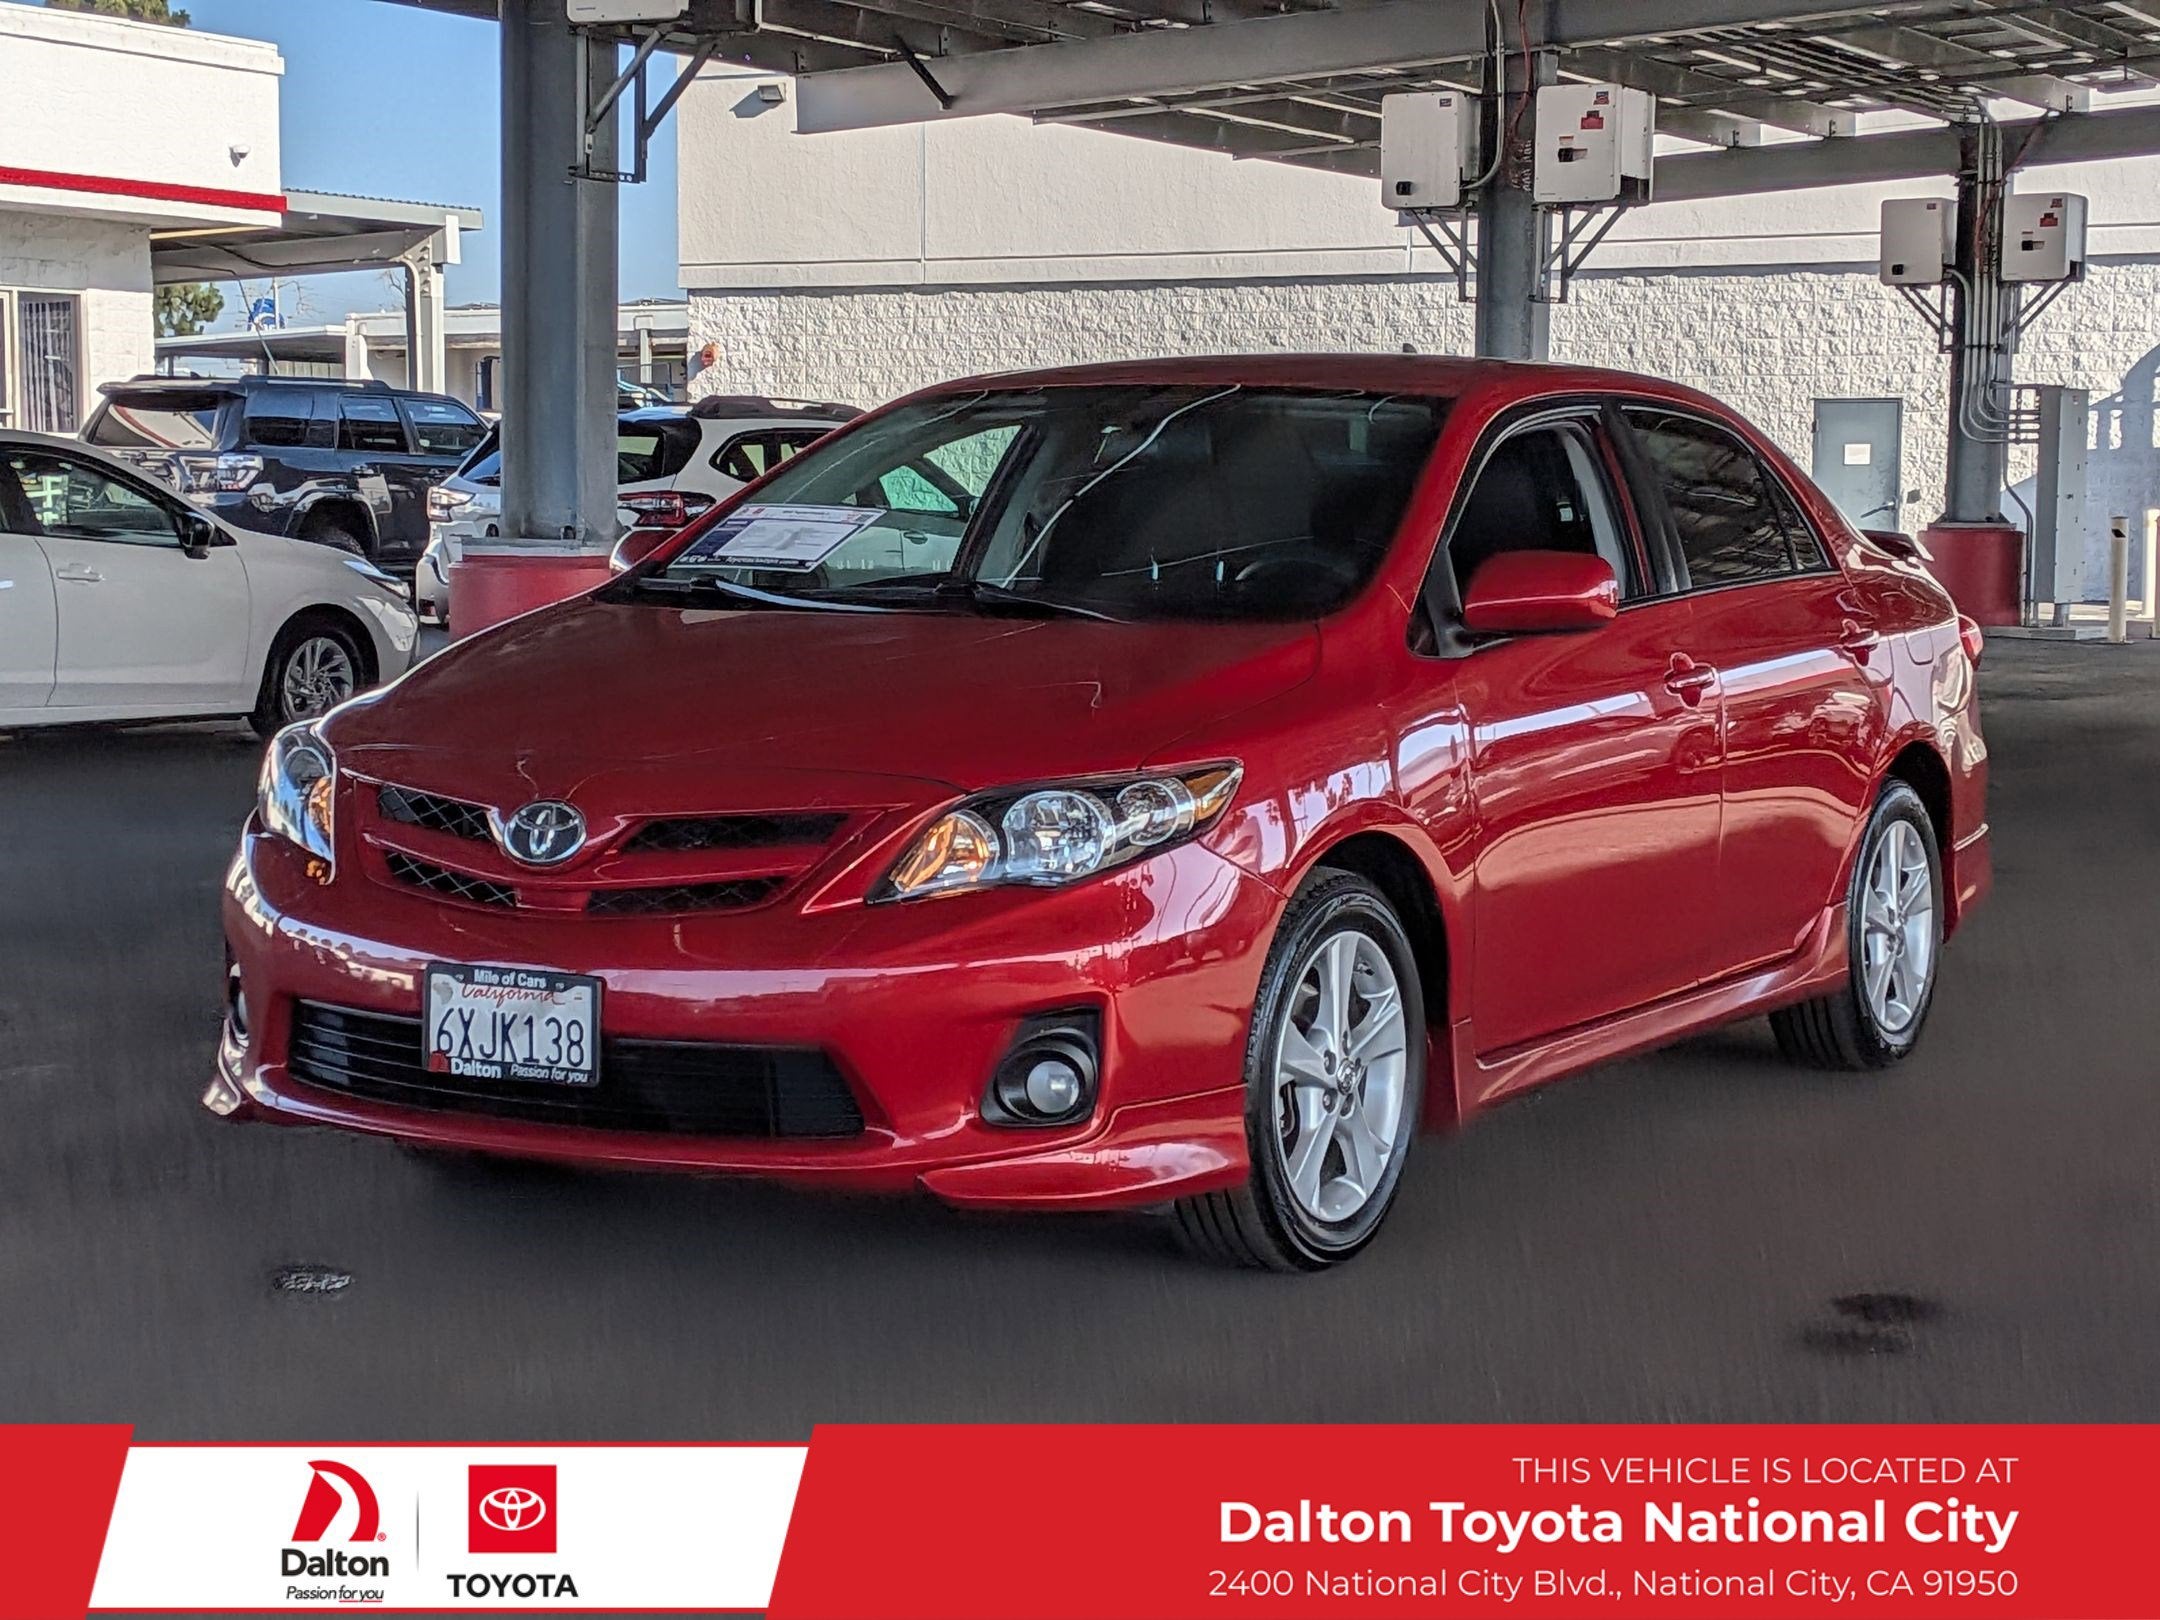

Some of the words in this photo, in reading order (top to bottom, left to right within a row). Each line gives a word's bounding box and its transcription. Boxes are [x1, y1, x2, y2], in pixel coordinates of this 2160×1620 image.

[473, 968, 500, 985] Mile
[501, 971, 515, 986] of
[517, 974, 547, 989] Cars
[461, 984, 565, 1008] California
[436, 1007, 585, 1067] 6XJK138
[450, 1058, 502, 1079] Dalton
[510, 1064, 549, 1079] Passion
[550, 1066, 565, 1081] for
[566, 1071, 588, 1084] you
